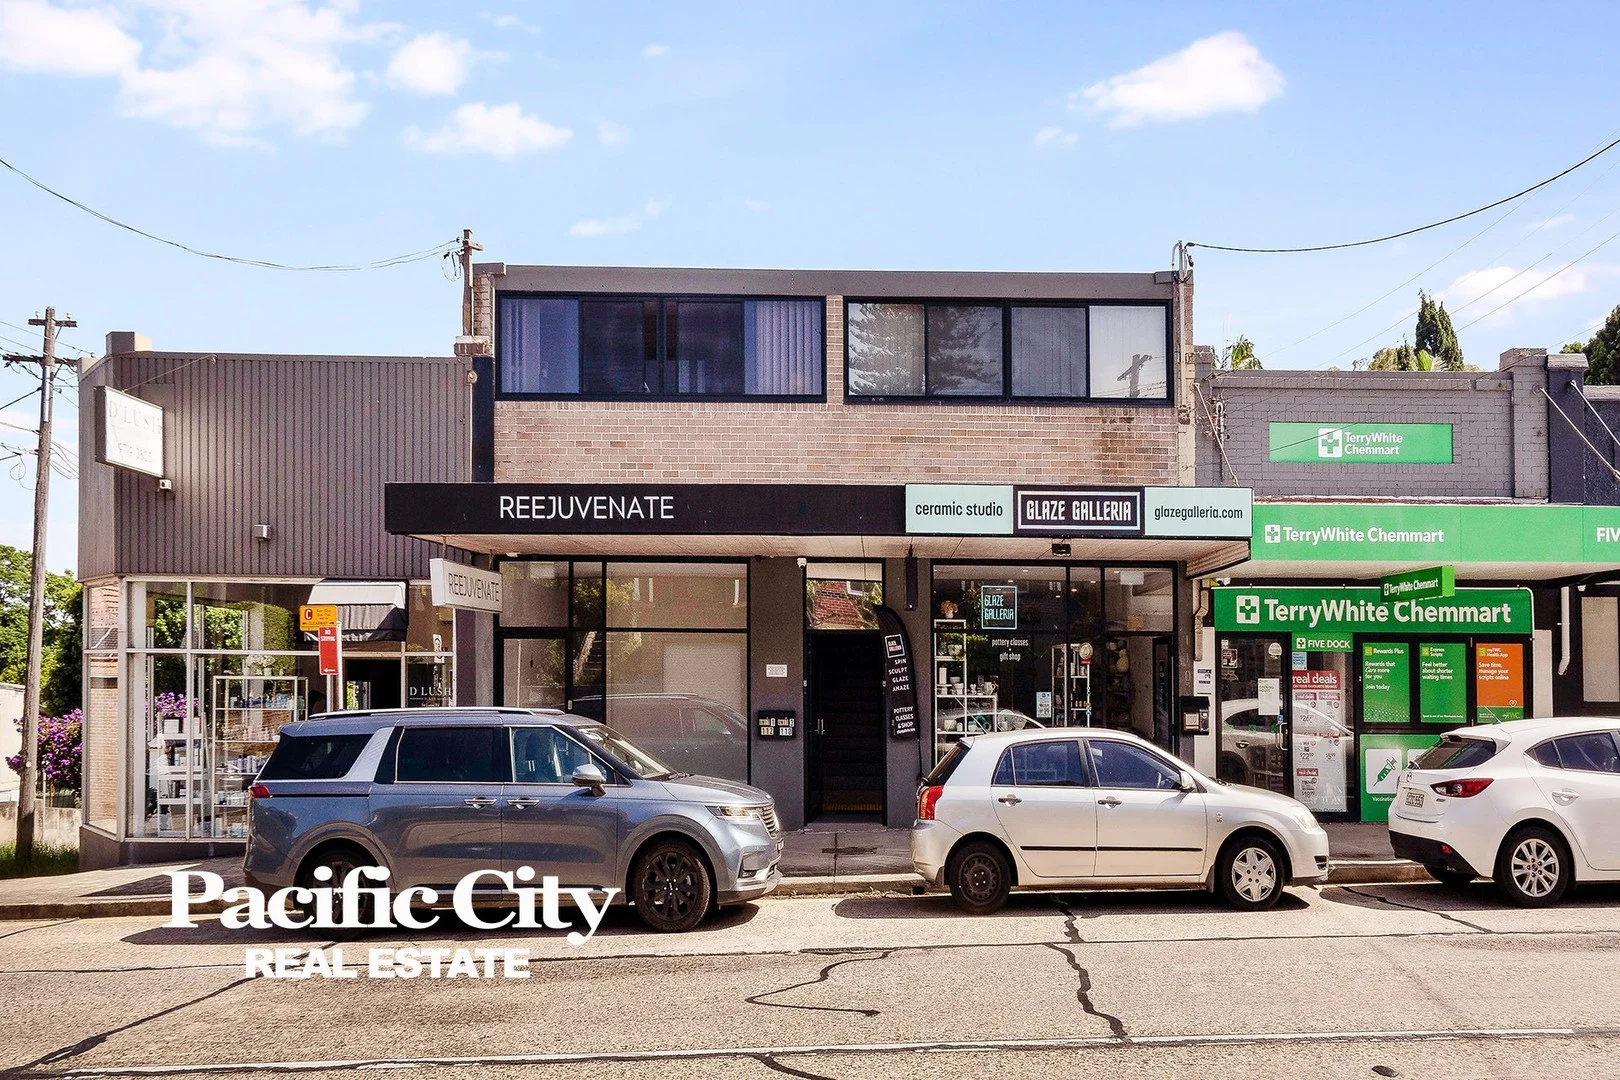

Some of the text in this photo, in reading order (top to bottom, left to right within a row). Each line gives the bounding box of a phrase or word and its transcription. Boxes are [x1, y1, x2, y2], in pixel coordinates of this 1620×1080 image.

[1344, 432, 1403, 446] TerryWhite
[1344, 444, 1400, 455] Chemmart
[500, 496, 674, 519] REEJUVENATE
[915, 501, 1004, 517] ceramic studio
[1026, 500, 1132, 522] GLAZE GALLERIA
[1154, 505, 1244, 521] glazegalleria.com
[1283, 526, 1445, 546] TerryWhite Chemmart
[448, 573, 500, 602] REEJUVENATE
[1389, 577, 1438, 596] TerryWhite Chemmart
[984, 595, 1004, 607] GLAZE
[305, 609, 312, 620] C
[984, 608, 1014, 620] GALLERIA
[1264, 599, 1512, 629] TerryWhite Chemmart
[991, 638, 1029, 647] pottery classes
[1308, 640, 1350, 649] FIVE DOCK
[1000, 652, 1021, 662] gift shop
[888, 666, 908, 675] SCULPT
[892, 675, 909, 684] GLAZE
[1292, 672, 1337, 684] real deals
[892, 684, 910, 692] AMAZE
[893, 706, 914, 714] POTTERY
[895, 713, 914, 722] CLASSES
